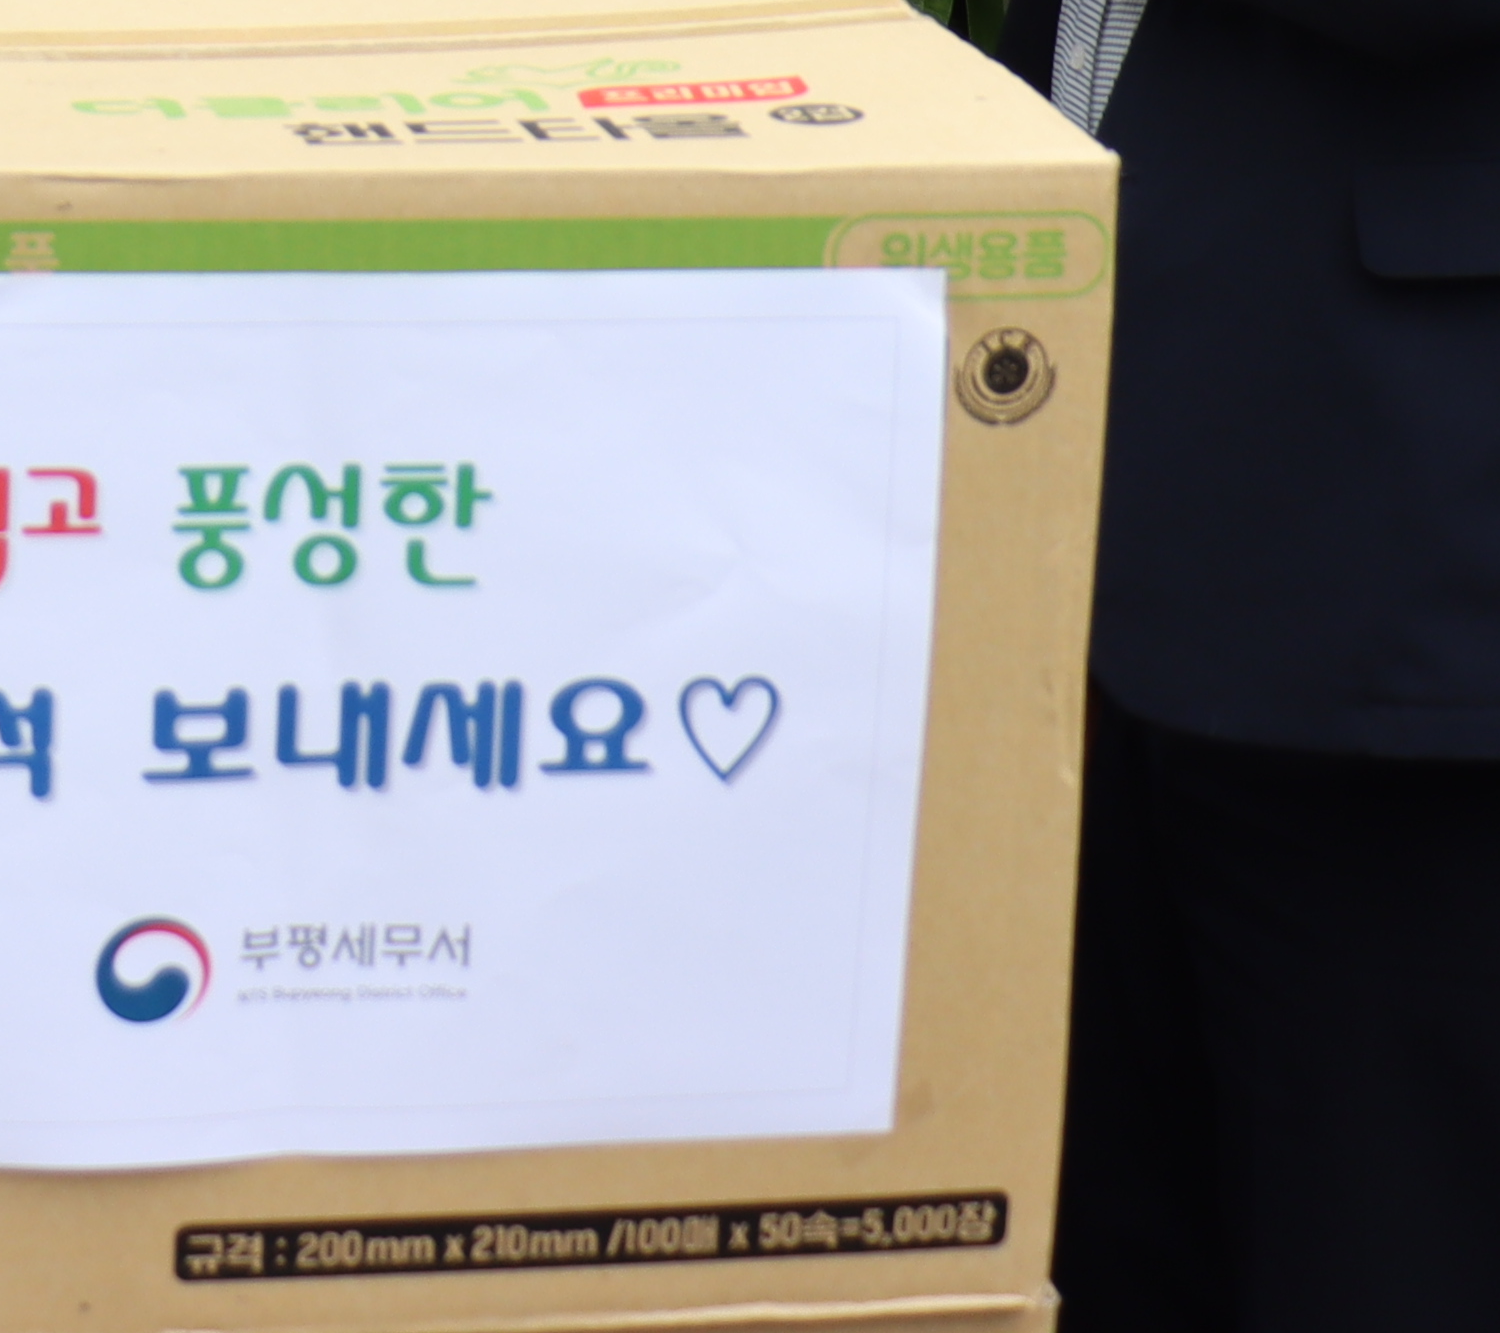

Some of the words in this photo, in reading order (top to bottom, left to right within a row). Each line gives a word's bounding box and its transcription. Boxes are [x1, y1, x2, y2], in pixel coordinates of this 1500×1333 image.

[601, 79, 796, 105] 프리미엄
[880, 228, 1068, 282] 위생용품
[176, 464, 491, 590] 풍성한
[143, 678, 651, 791] 보내세요
[242, 923, 473, 971] 부평세무서
[184, 1231, 266, 1275] 규격
[296, 1229, 437, 1270] 200mm
[471, 1224, 599, 1263] 210mm
